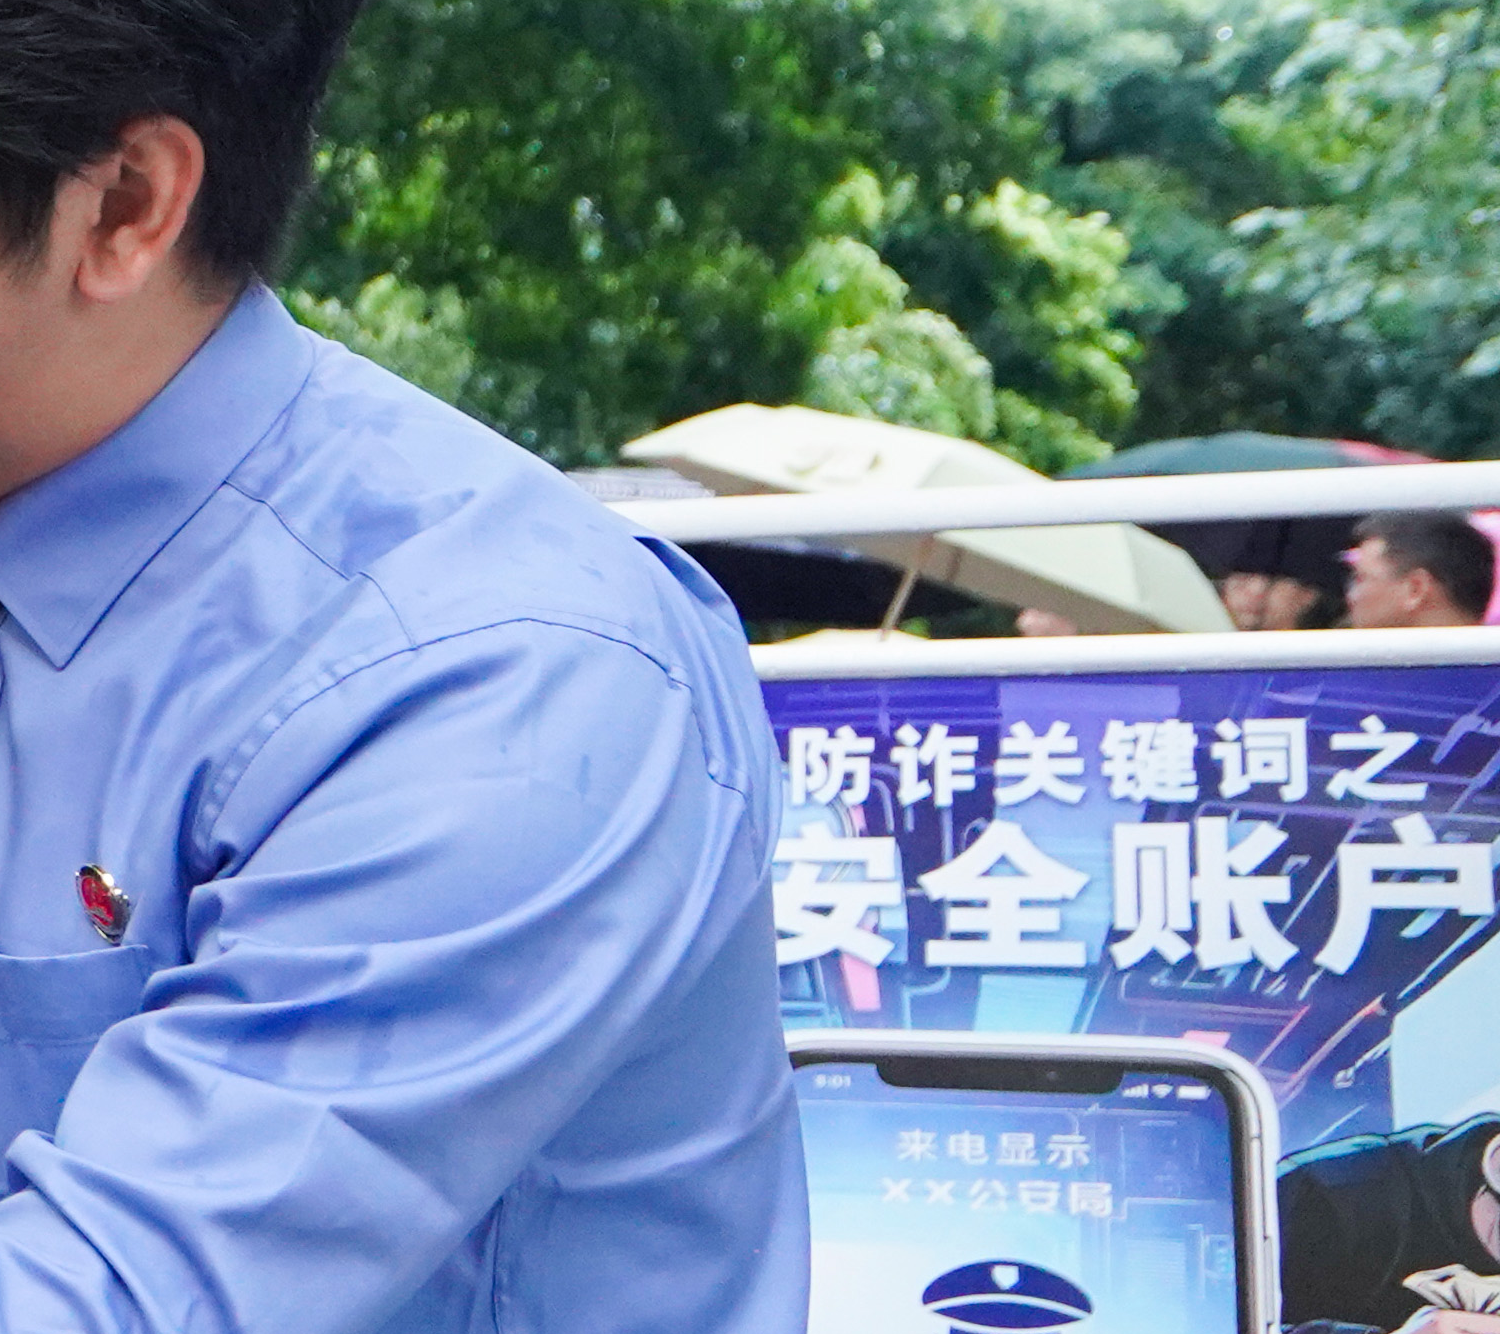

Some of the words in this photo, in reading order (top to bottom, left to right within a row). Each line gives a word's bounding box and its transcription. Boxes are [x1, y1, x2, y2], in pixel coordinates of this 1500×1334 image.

[788, 714, 1428, 809] 防诈关键词之
[775, 812, 1499, 976] 安全账户
[898, 1127, 1091, 1169] 来电显示
